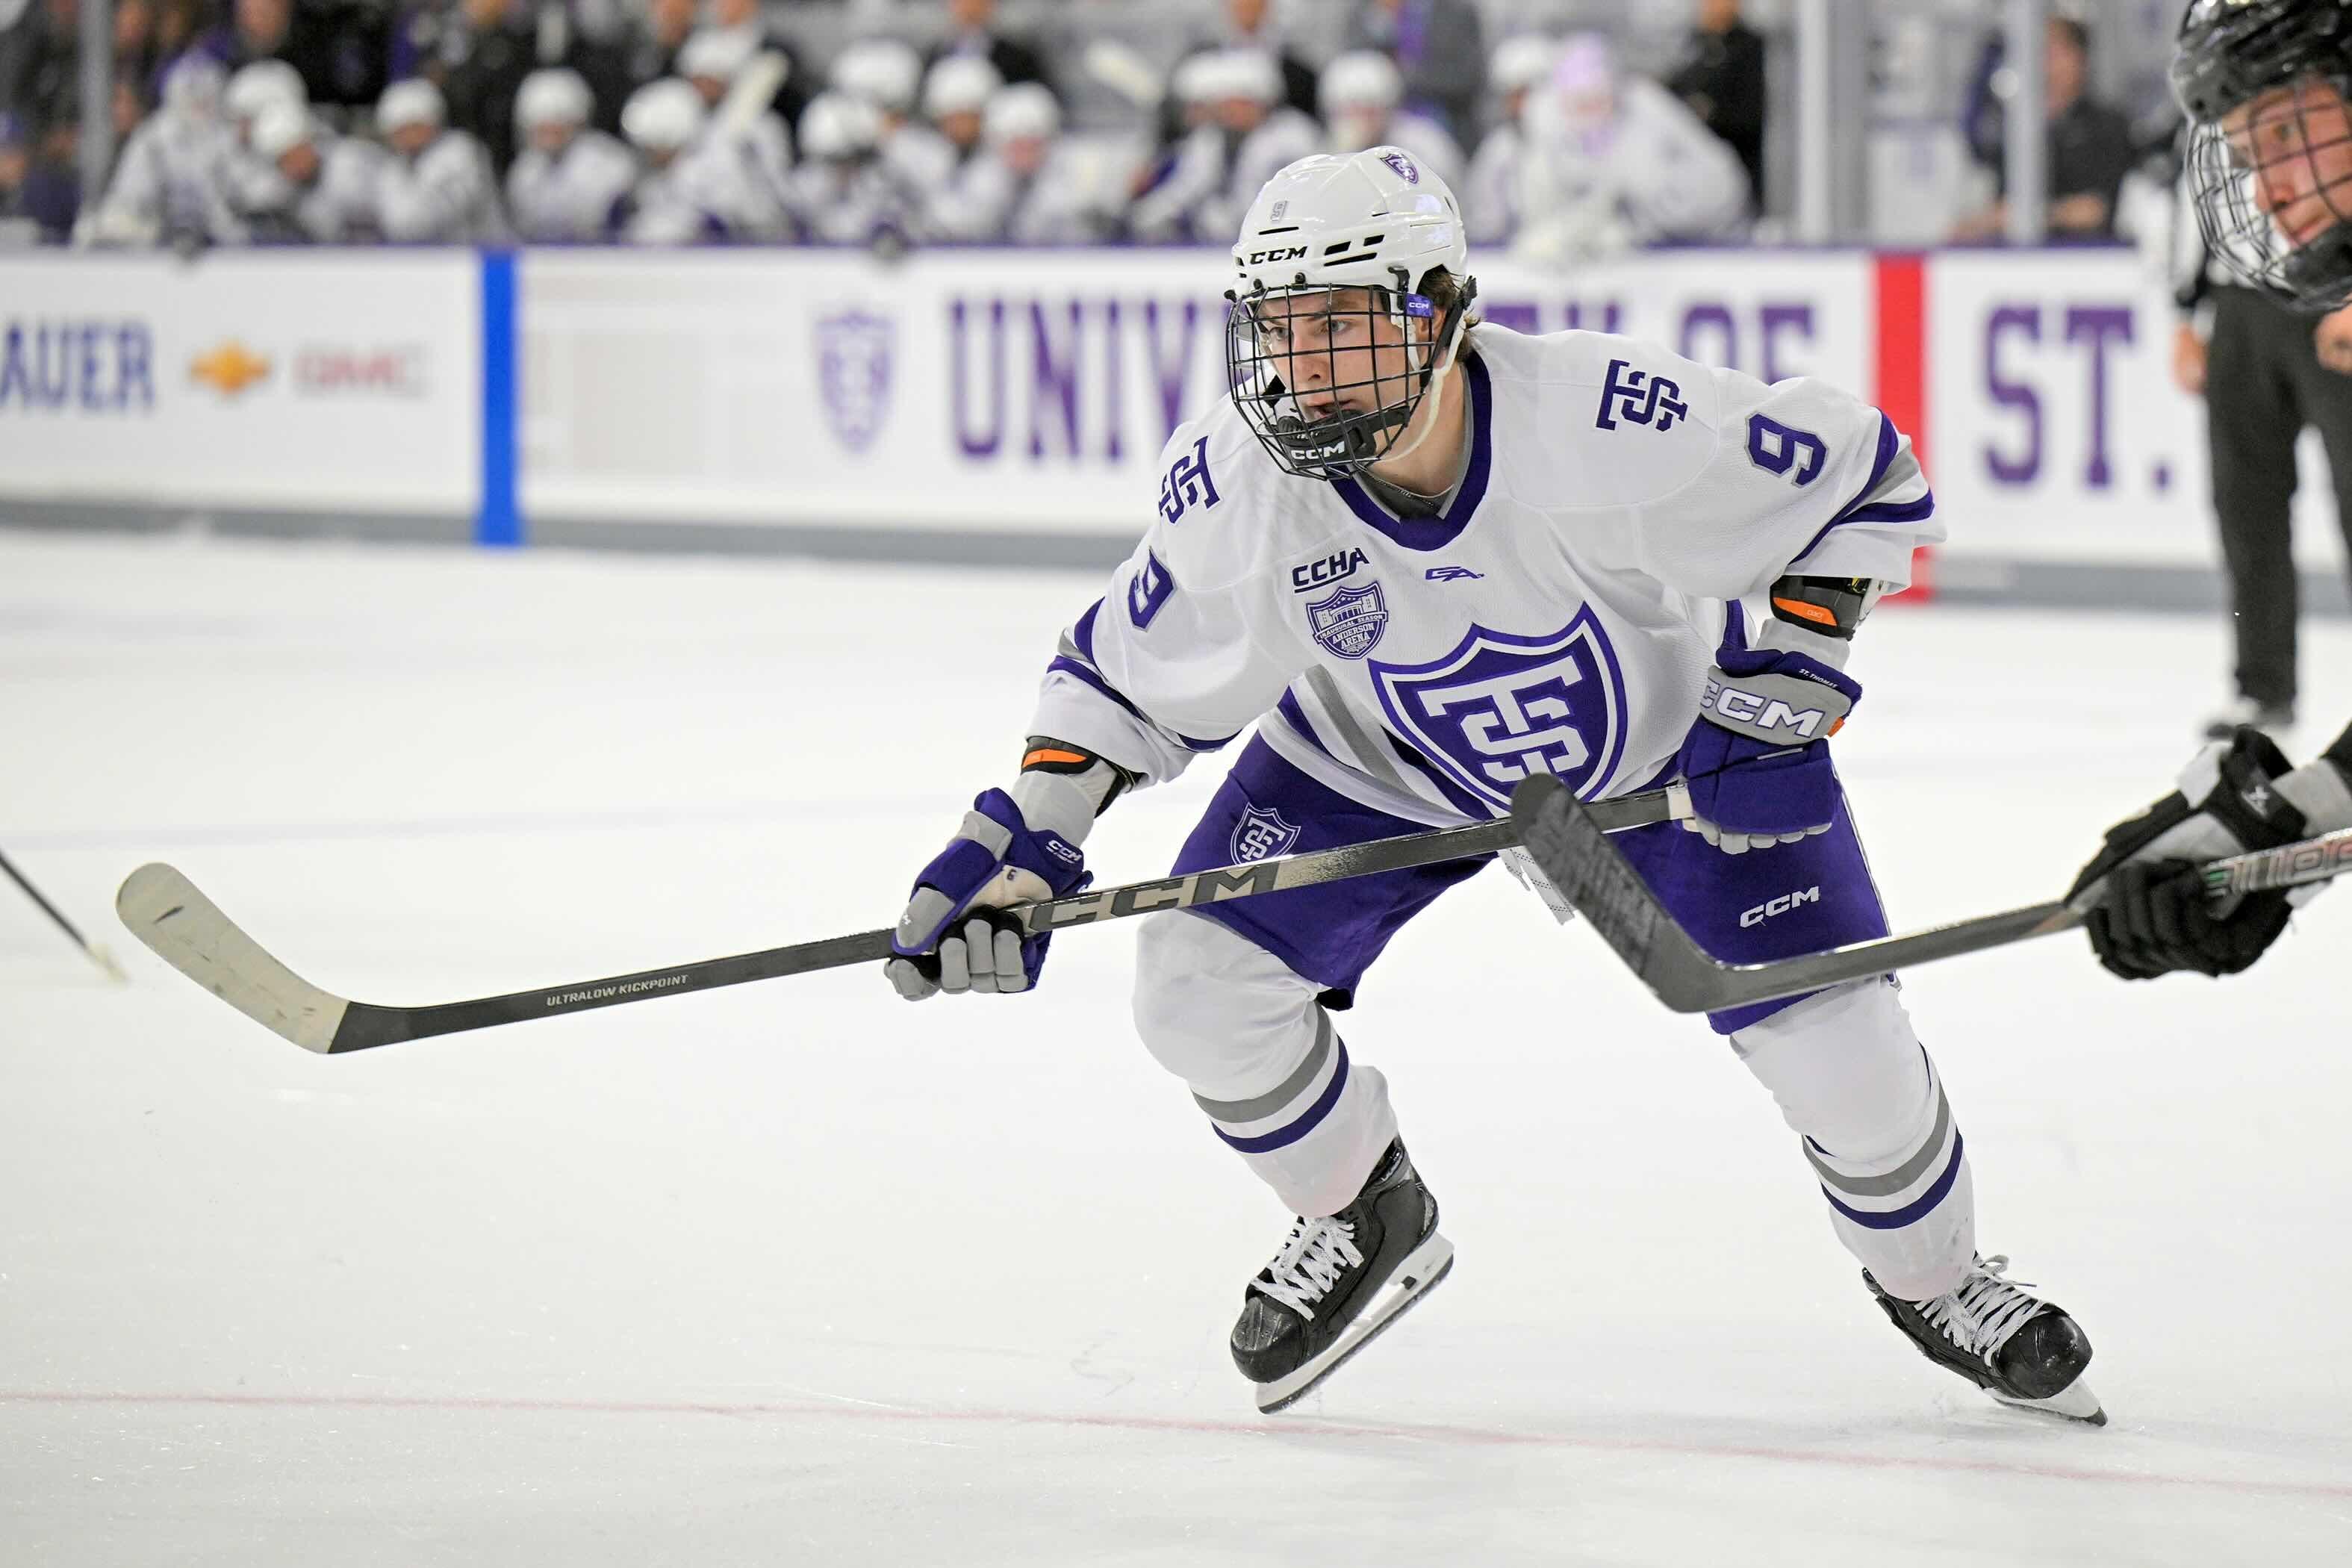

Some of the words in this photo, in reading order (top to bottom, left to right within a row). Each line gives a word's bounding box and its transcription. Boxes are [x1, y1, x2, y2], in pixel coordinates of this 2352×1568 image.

[1250, 246, 1308, 265] CCM
[1982, 303, 2174, 490] ST.
[1290, 441, 1345, 461] CCM
[1744, 411, 1829, 488] 9
[1292, 547, 1369, 588] CCHA
[1127, 547, 1177, 632] 9
[1319, 620, 1355, 638] INAUGURAL
[1357, 614, 1384, 623] SEASON
[1332, 622, 1375, 644] ANDERSON
[1341, 632, 1372, 650] ARENA
[1799, 668, 1810, 676] ST.
[1809, 673, 1839, 688] THOMAS
[1699, 677, 1826, 738] CCM
[1048, 839, 1083, 862] CCM
[1029, 860, 1281, 932] CCM
[1740, 886, 1820, 928] CCM
[546, 986, 617, 1007] ULTRALOW
[618, 974, 688, 995] KICKPOINT
